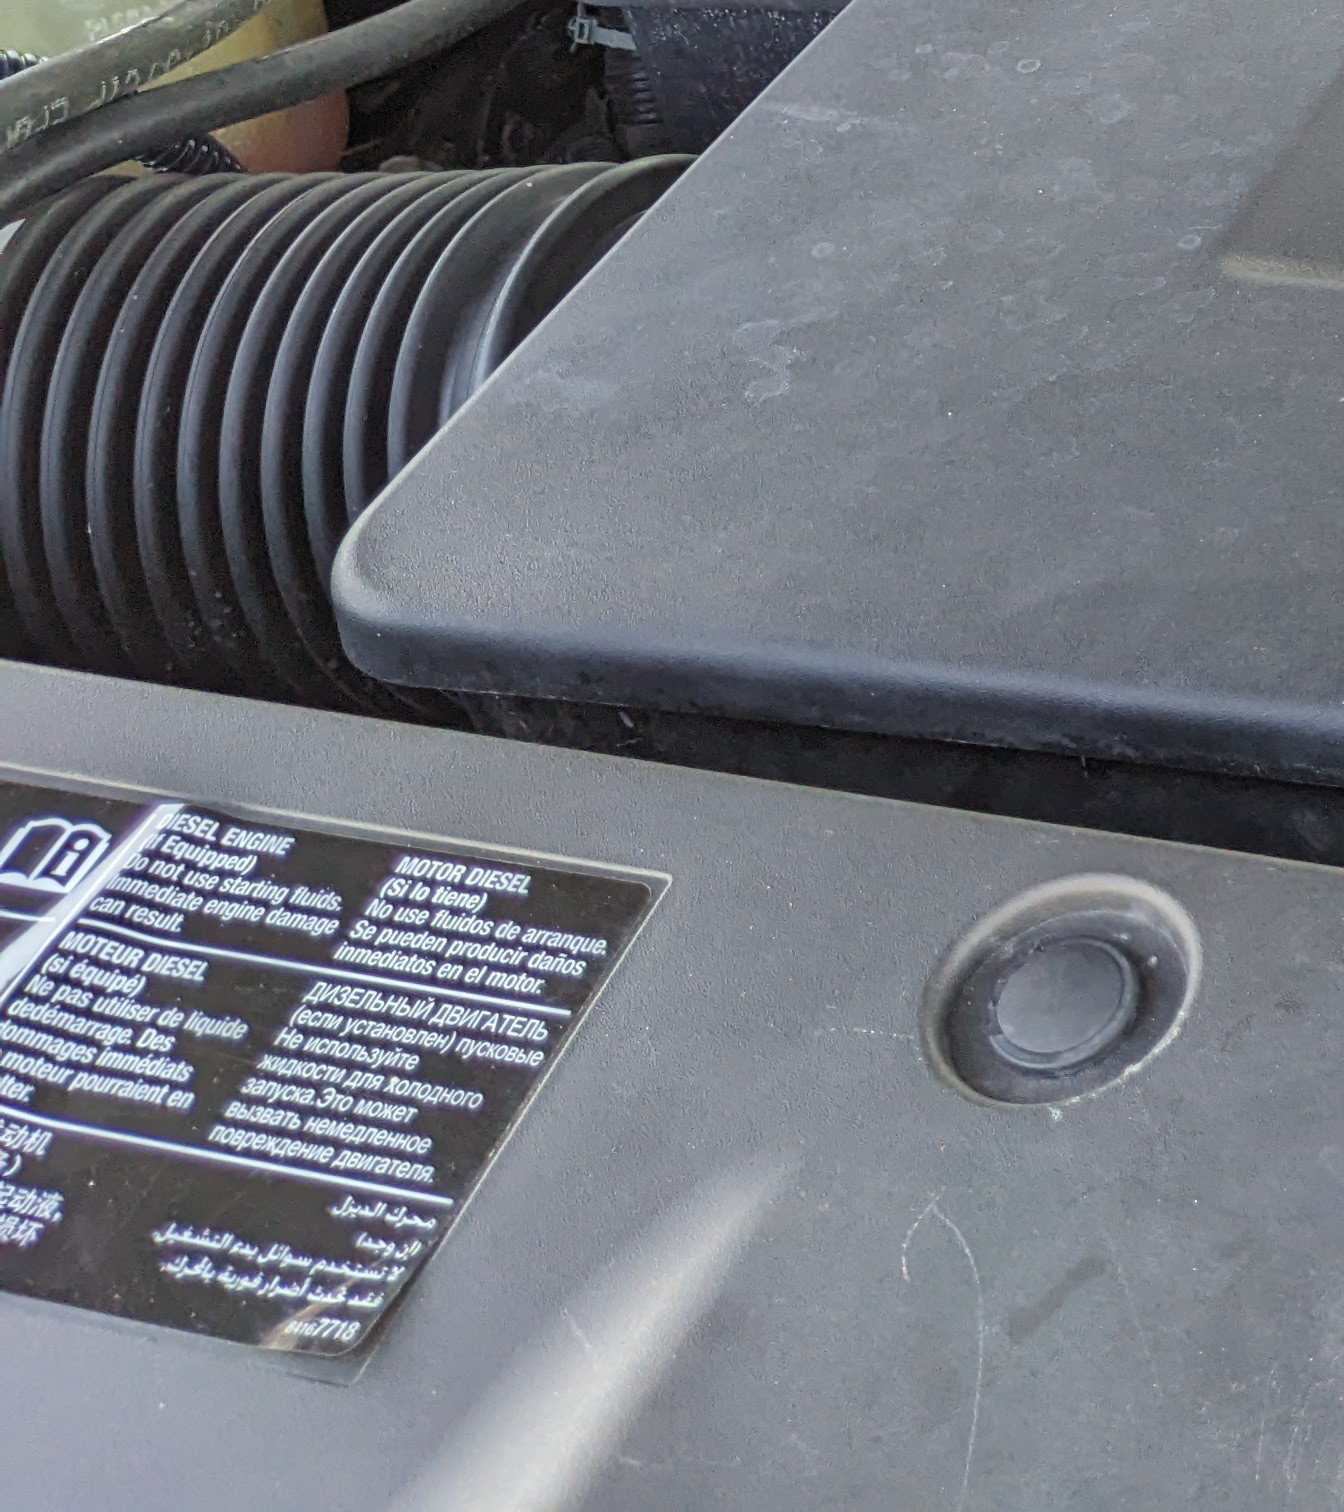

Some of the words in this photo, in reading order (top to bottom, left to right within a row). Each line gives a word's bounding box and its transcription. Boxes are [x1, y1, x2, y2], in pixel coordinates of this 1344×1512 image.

[157, 812, 222, 842] DIESEL
[219, 826, 296, 856] ENGINE
[160, 835, 259, 876] Equipped)
[123, 853, 149, 870] Do
[147, 858, 185, 881] not
[183, 869, 220, 890] use
[218, 876, 290, 906] starting
[288, 884, 344, 913] fluids.
[378, 877, 410, 898] (Si
[409, 881, 432, 901] lo
[430, 885, 489, 914] tiene)
[394, 855, 467, 882] MOTOR
[465, 866, 533, 895] DIESEL
[90, 895, 129, 916] can
[124, 903, 184, 933] result.
[109, 874, 204, 912] Immediate
[203, 899, 266, 921] engine
[264, 906, 340, 936] damage
[363, 898, 394, 919] No
[392, 907, 430, 926] use
[430, 908, 495, 938] fluidos
[493, 919, 522, 940] de
[520, 926, 608, 956] arranque.
[57, 930, 147, 967] MOTEUR
[140, 951, 210, 982] DIESEL
[333, 939, 437, 976] inmediatos
[435, 962, 465, 981] en
[464, 963, 486, 985] el
[483, 972, 547, 995] motor.
[349, 919, 377, 940] Se
[374, 926, 449, 954] pueden
[445, 937, 529, 966] producir
[527, 950, 588, 976] daños
[40, 952, 70, 976] (si
[69, 958, 148, 998] équipé)
[23, 974, 54, 996] Ne
[48, 984, 95, 1008] pas
[91, 991, 160, 1023] utiliser
[155, 1006, 186, 1029] de
[182, 1011, 250, 1042] liquide
[301, 980, 437, 1022] ДИЗЕЛЬНЫЙ
[428, 1002, 549, 1042] ДВИГАТЕЛЬ
[135, 1028, 177, 1053] Des
[272, 1026, 303, 1049] Не
[302, 1035, 421, 1072] используйте
[288, 1005, 341, 1030] (если
[341, 1017, 457, 1054] установлен)
[454, 1036, 546, 1068] пусковые
[0, 1050, 76, 1085] moteur
[67, 1071, 170, 1109] pourraient
[165, 1089, 197, 1110] en
[94, 1047, 196, 1084] immédiats
[255, 1051, 349, 1084] жидкости
[343, 1068, 384, 1090] для
[382, 1075, 485, 1110] холодного
[222, 1100, 304, 1130] вызвать
[302, 1114, 433, 1156] немедленное
[351, 1097, 419, 1125] может
[207, 1124, 336, 1165] повреждение
[331, 1148, 436, 1185] двигателя.
[328, 1194, 388, 1219] الديزل
[384, 1205, 438, 1229] محرك
[151, 1221, 235, 1250] التشغيل
[256, 1243, 313, 1269] سوائل
